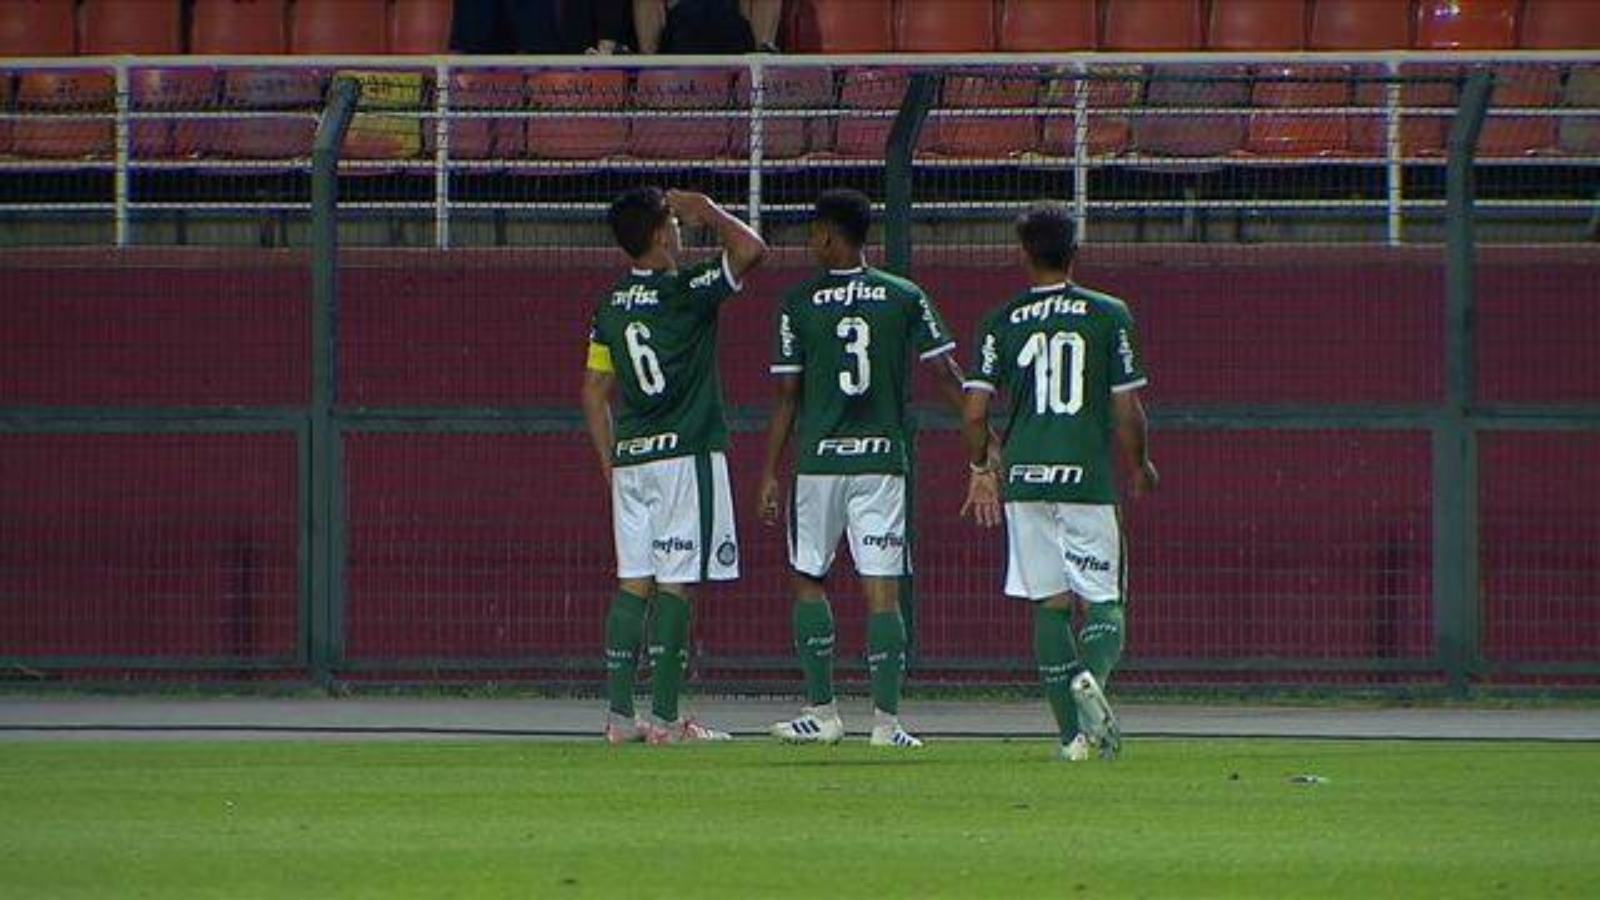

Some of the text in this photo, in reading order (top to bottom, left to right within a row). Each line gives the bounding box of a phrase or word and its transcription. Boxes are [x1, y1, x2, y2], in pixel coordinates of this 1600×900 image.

[813, 281, 887, 306] crefisa
[1009, 294, 1088, 324] crefisa
[625, 321, 666, 396] 6
[836, 316, 870, 396] 3
[1017, 331, 1086, 415] 10
